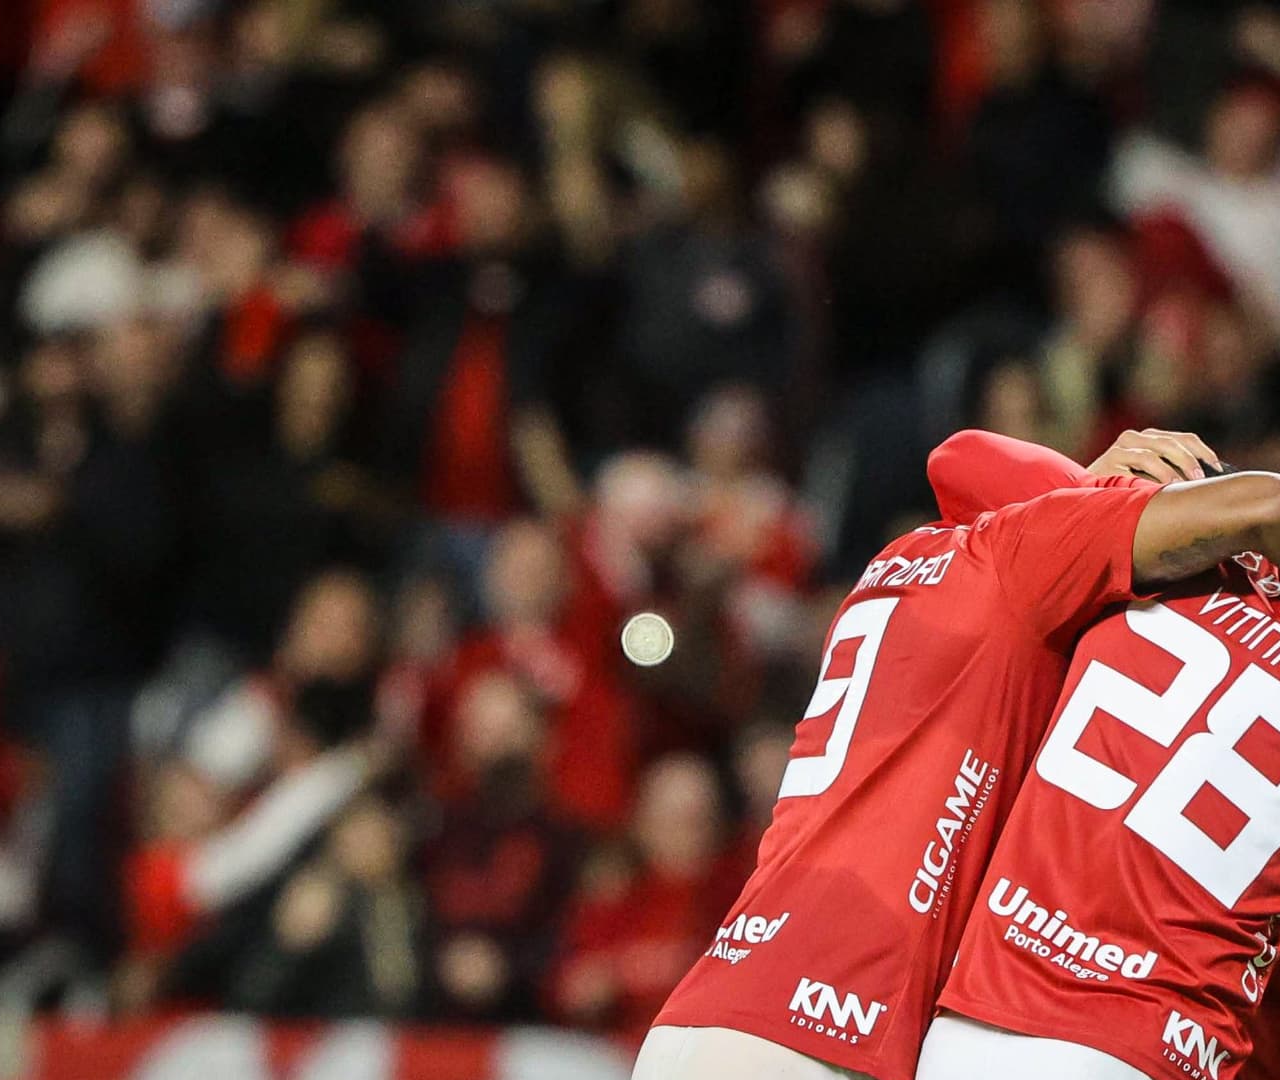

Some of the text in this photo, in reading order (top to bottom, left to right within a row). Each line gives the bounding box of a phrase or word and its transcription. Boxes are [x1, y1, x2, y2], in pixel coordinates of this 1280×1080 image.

[777, 597, 901, 799] 9
[908, 748, 989, 914] CIGAME
[987, 877, 1159, 979] Unimed
[1004, 924, 1110, 983] Porto Alegre
[788, 976, 884, 1036] KNN
[790, 1015, 859, 1044] IDIOMAS
